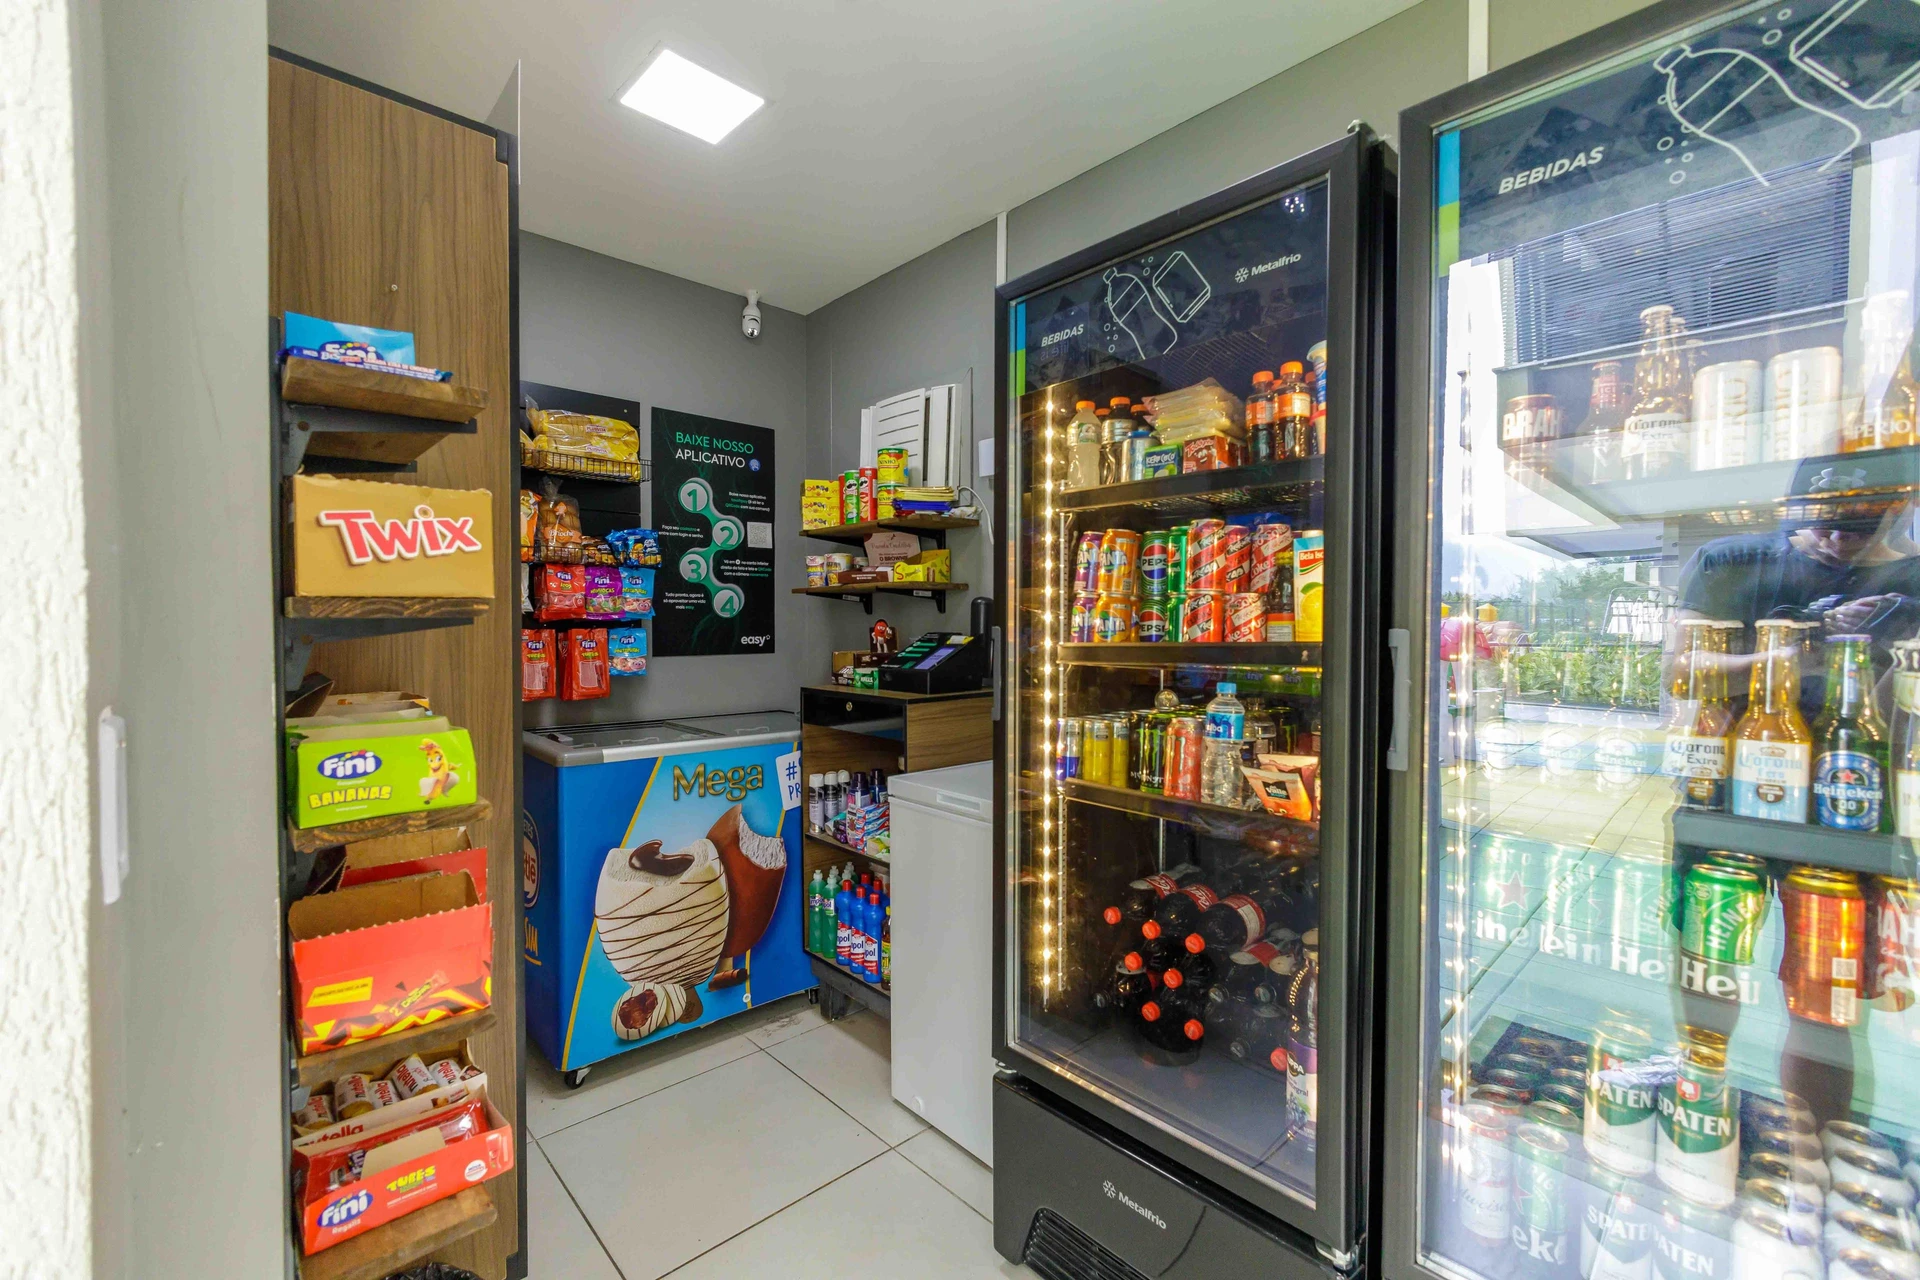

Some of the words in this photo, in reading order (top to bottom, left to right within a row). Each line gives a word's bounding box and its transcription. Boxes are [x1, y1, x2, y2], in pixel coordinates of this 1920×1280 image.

[1499, 147, 1604, 195] BEBIDAS
[1251, 253, 1301, 276] Metalfrio
[1041, 323, 1084, 348] BEBIDAS
[675, 431, 710, 448] BAIXE
[713, 437, 754, 455] NOSSO
[675, 448, 746, 468] APLICATIVO
[687, 488, 698, 512] 1
[317, 505, 483, 566] Twix
[720, 525, 735, 549] 2
[1300, 551, 1314, 560] Bela
[687, 560, 702, 583] 3
[720, 595, 736, 617] 4
[527, 641, 544, 649] Fini
[581, 640, 597, 649] Fini
[740, 636, 766, 647] easy
[1670, 739, 1726, 758] Corona
[1686, 754, 1718, 766] Extra
[1738, 751, 1803, 769] Corona
[323, 751, 376, 778] Fini
[673, 762, 764, 802] Mega
[1813, 782, 1884, 800] Heineken
[308, 786, 393, 809] BANANAS
[396, 1063, 419, 1092] nutella
[1657, 1092, 1732, 1137] SPATEN
[385, 1165, 437, 1192] TUBES
[321, 1188, 368, 1226] Fini
[1118, 1190, 1167, 1230] Metalfrio
